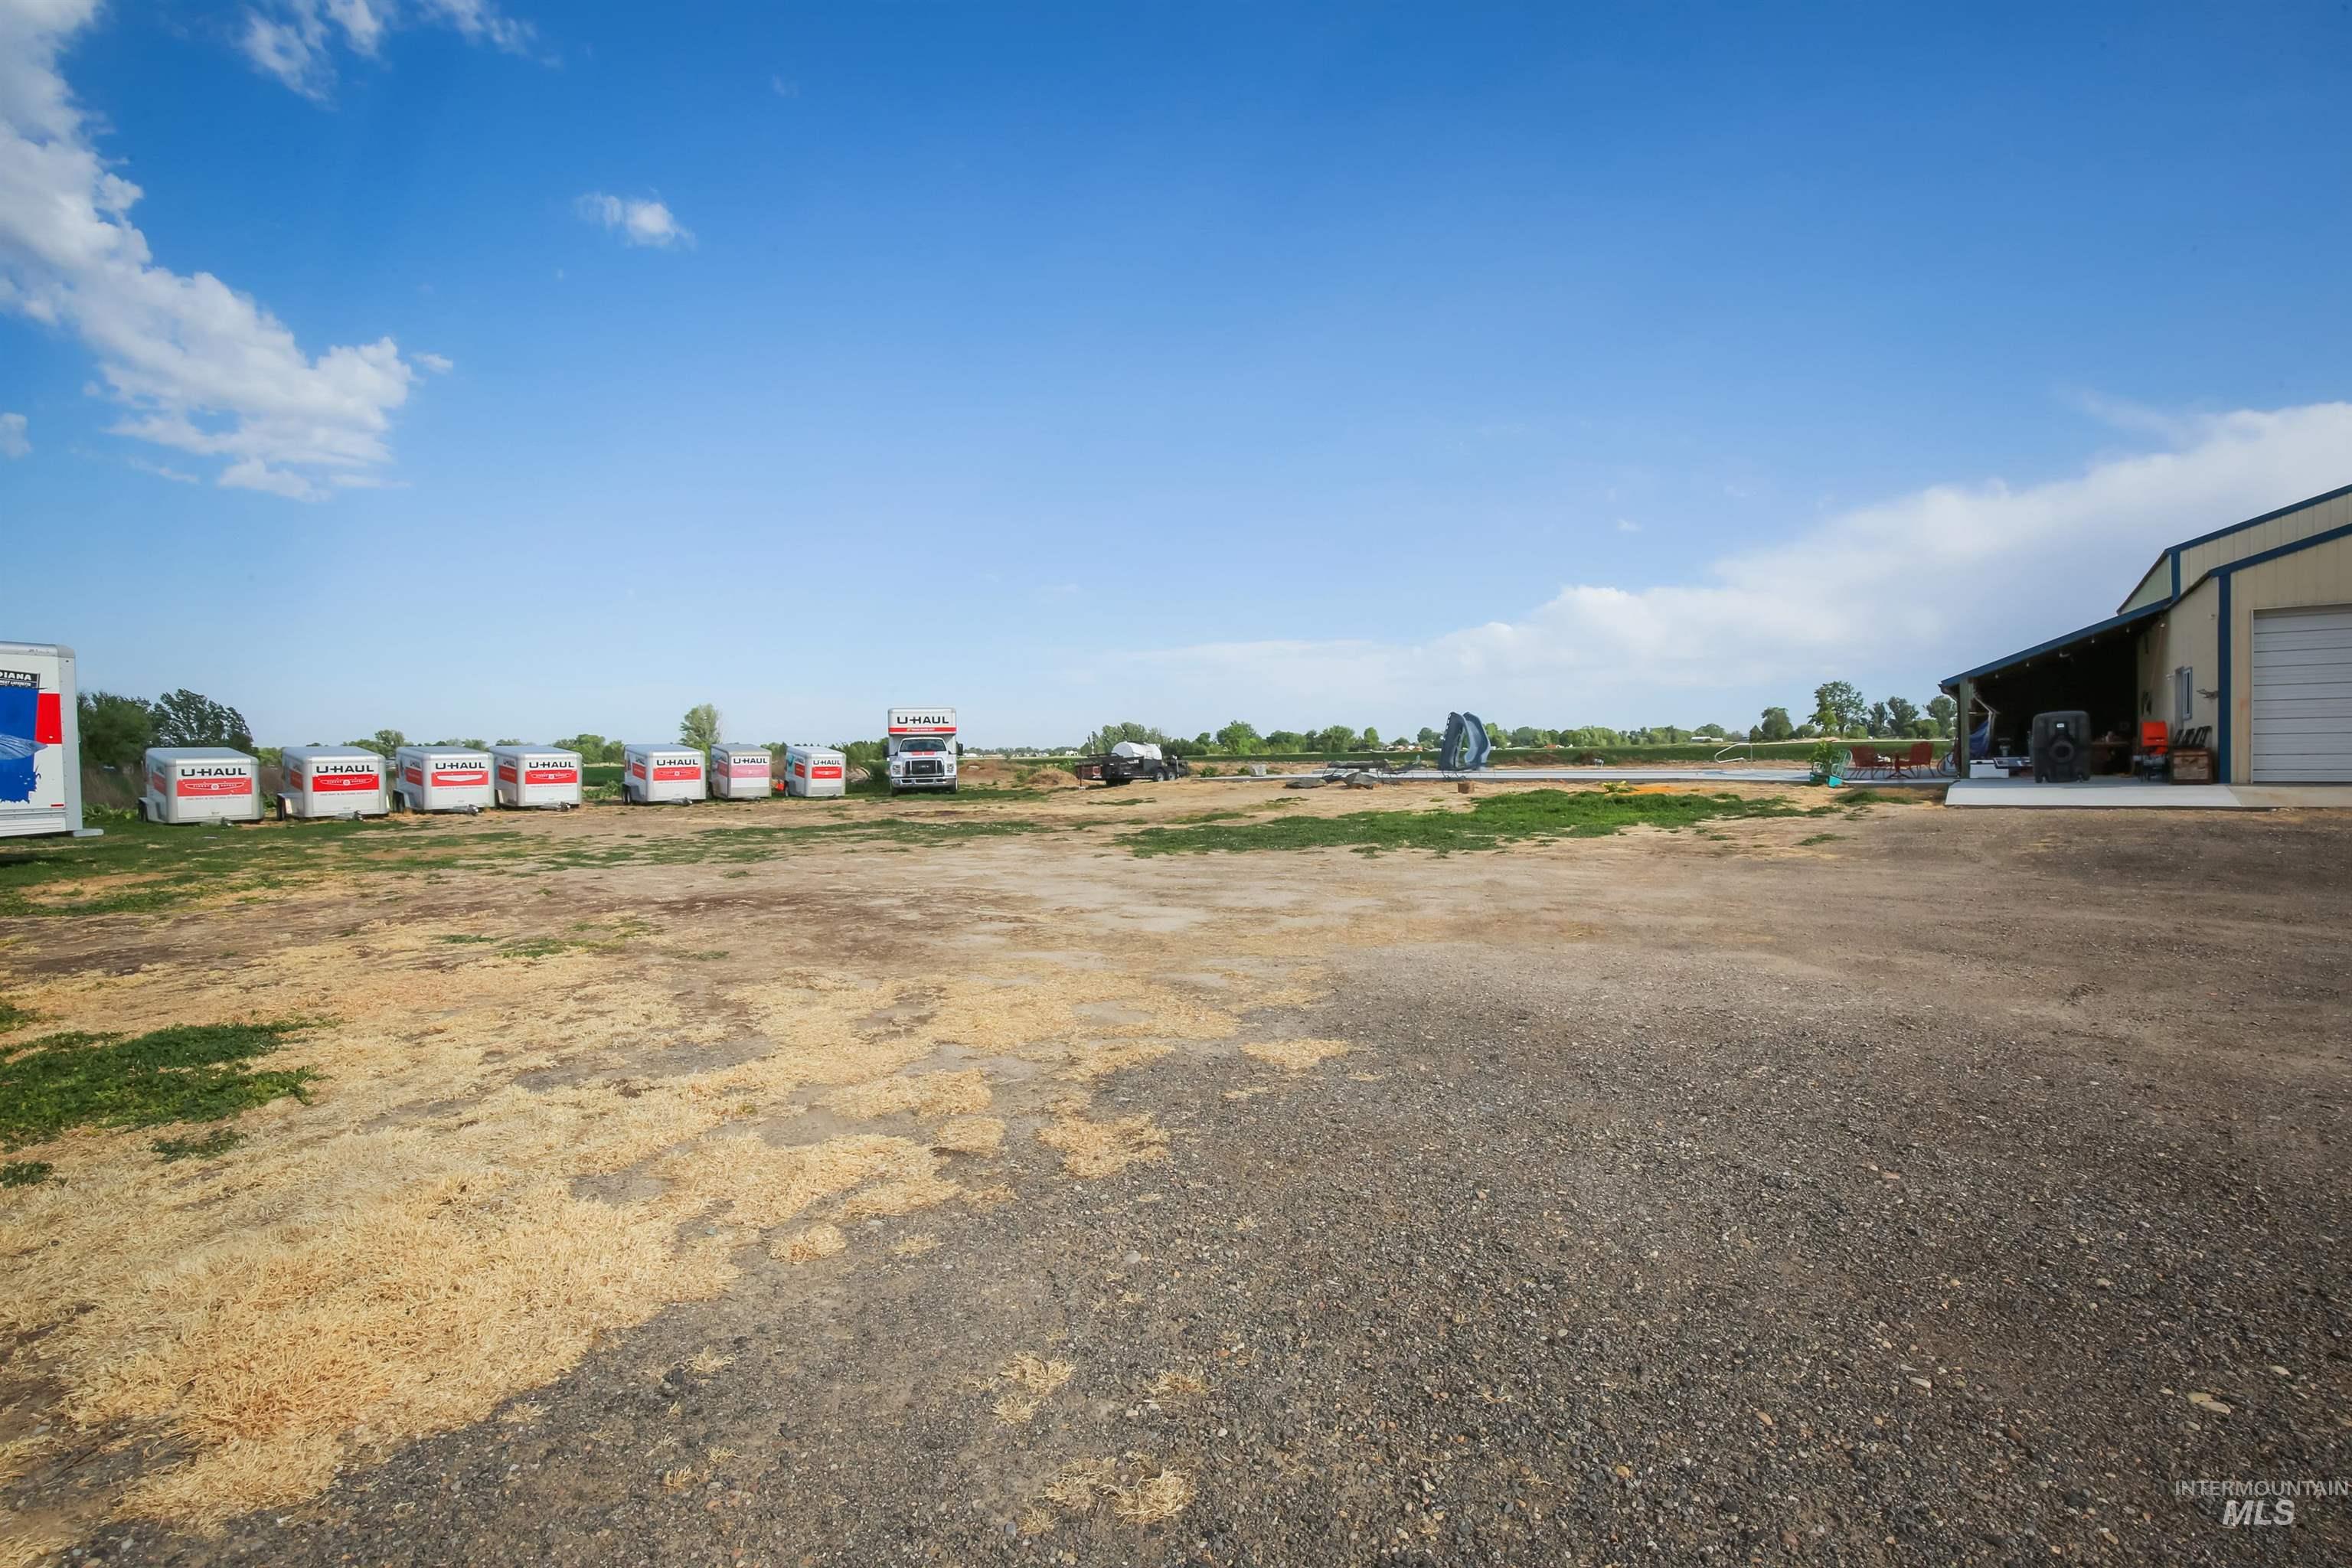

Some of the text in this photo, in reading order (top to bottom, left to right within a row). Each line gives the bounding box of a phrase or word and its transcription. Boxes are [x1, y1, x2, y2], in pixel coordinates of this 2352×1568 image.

[897, 716, 949, 724] U-HAUL
[181, 767, 247, 777] U-HAUL
[315, 764, 374, 773] U-HAUL
